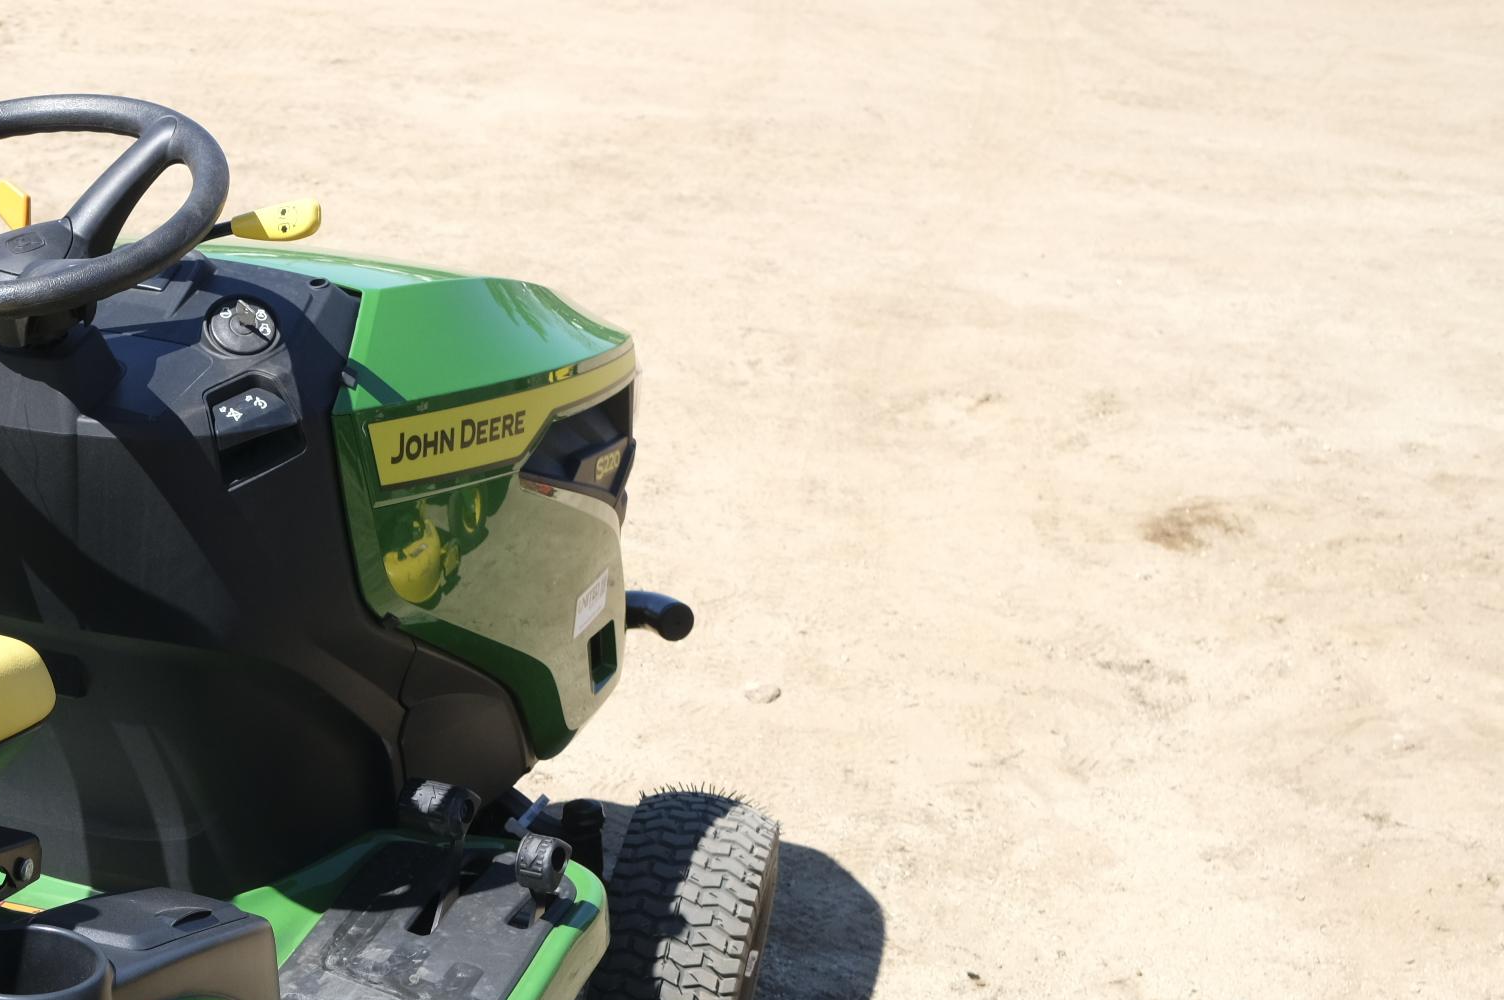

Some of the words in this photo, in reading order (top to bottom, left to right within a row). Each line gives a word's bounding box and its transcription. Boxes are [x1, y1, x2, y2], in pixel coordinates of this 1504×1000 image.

[391, 427, 454, 464] JOHN
[460, 410, 526, 448] DEERE
[595, 448, 620, 481] S220
